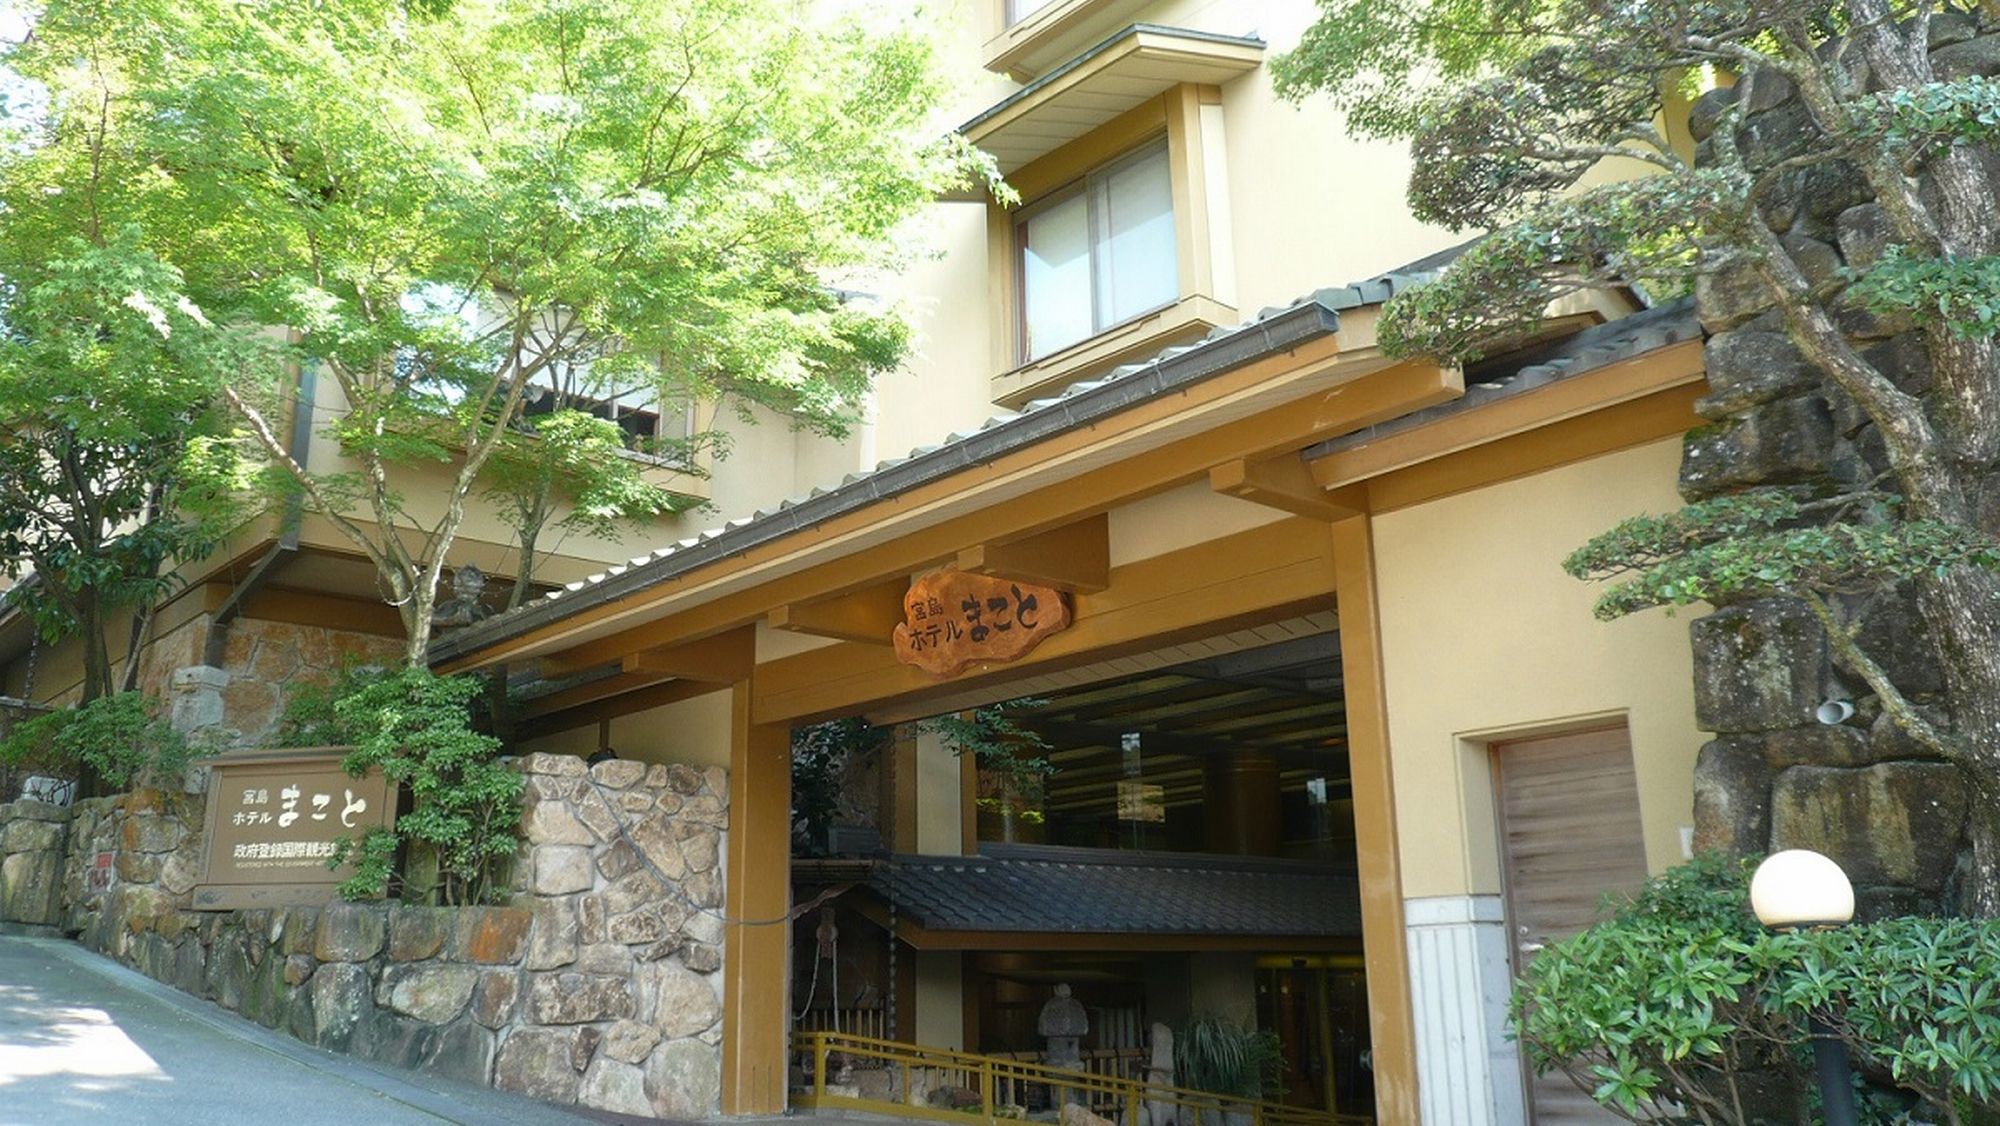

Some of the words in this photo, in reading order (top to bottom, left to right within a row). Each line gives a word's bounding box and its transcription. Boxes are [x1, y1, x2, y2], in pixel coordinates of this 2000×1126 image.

[911, 597, 943, 621] 宮島
[961, 583, 1038, 643] まこと
[909, 620, 963, 651] ホテル
[243, 789, 268, 805] 宮島
[278, 784, 366, 827] まこと
[233, 811, 273, 826] ホテル
